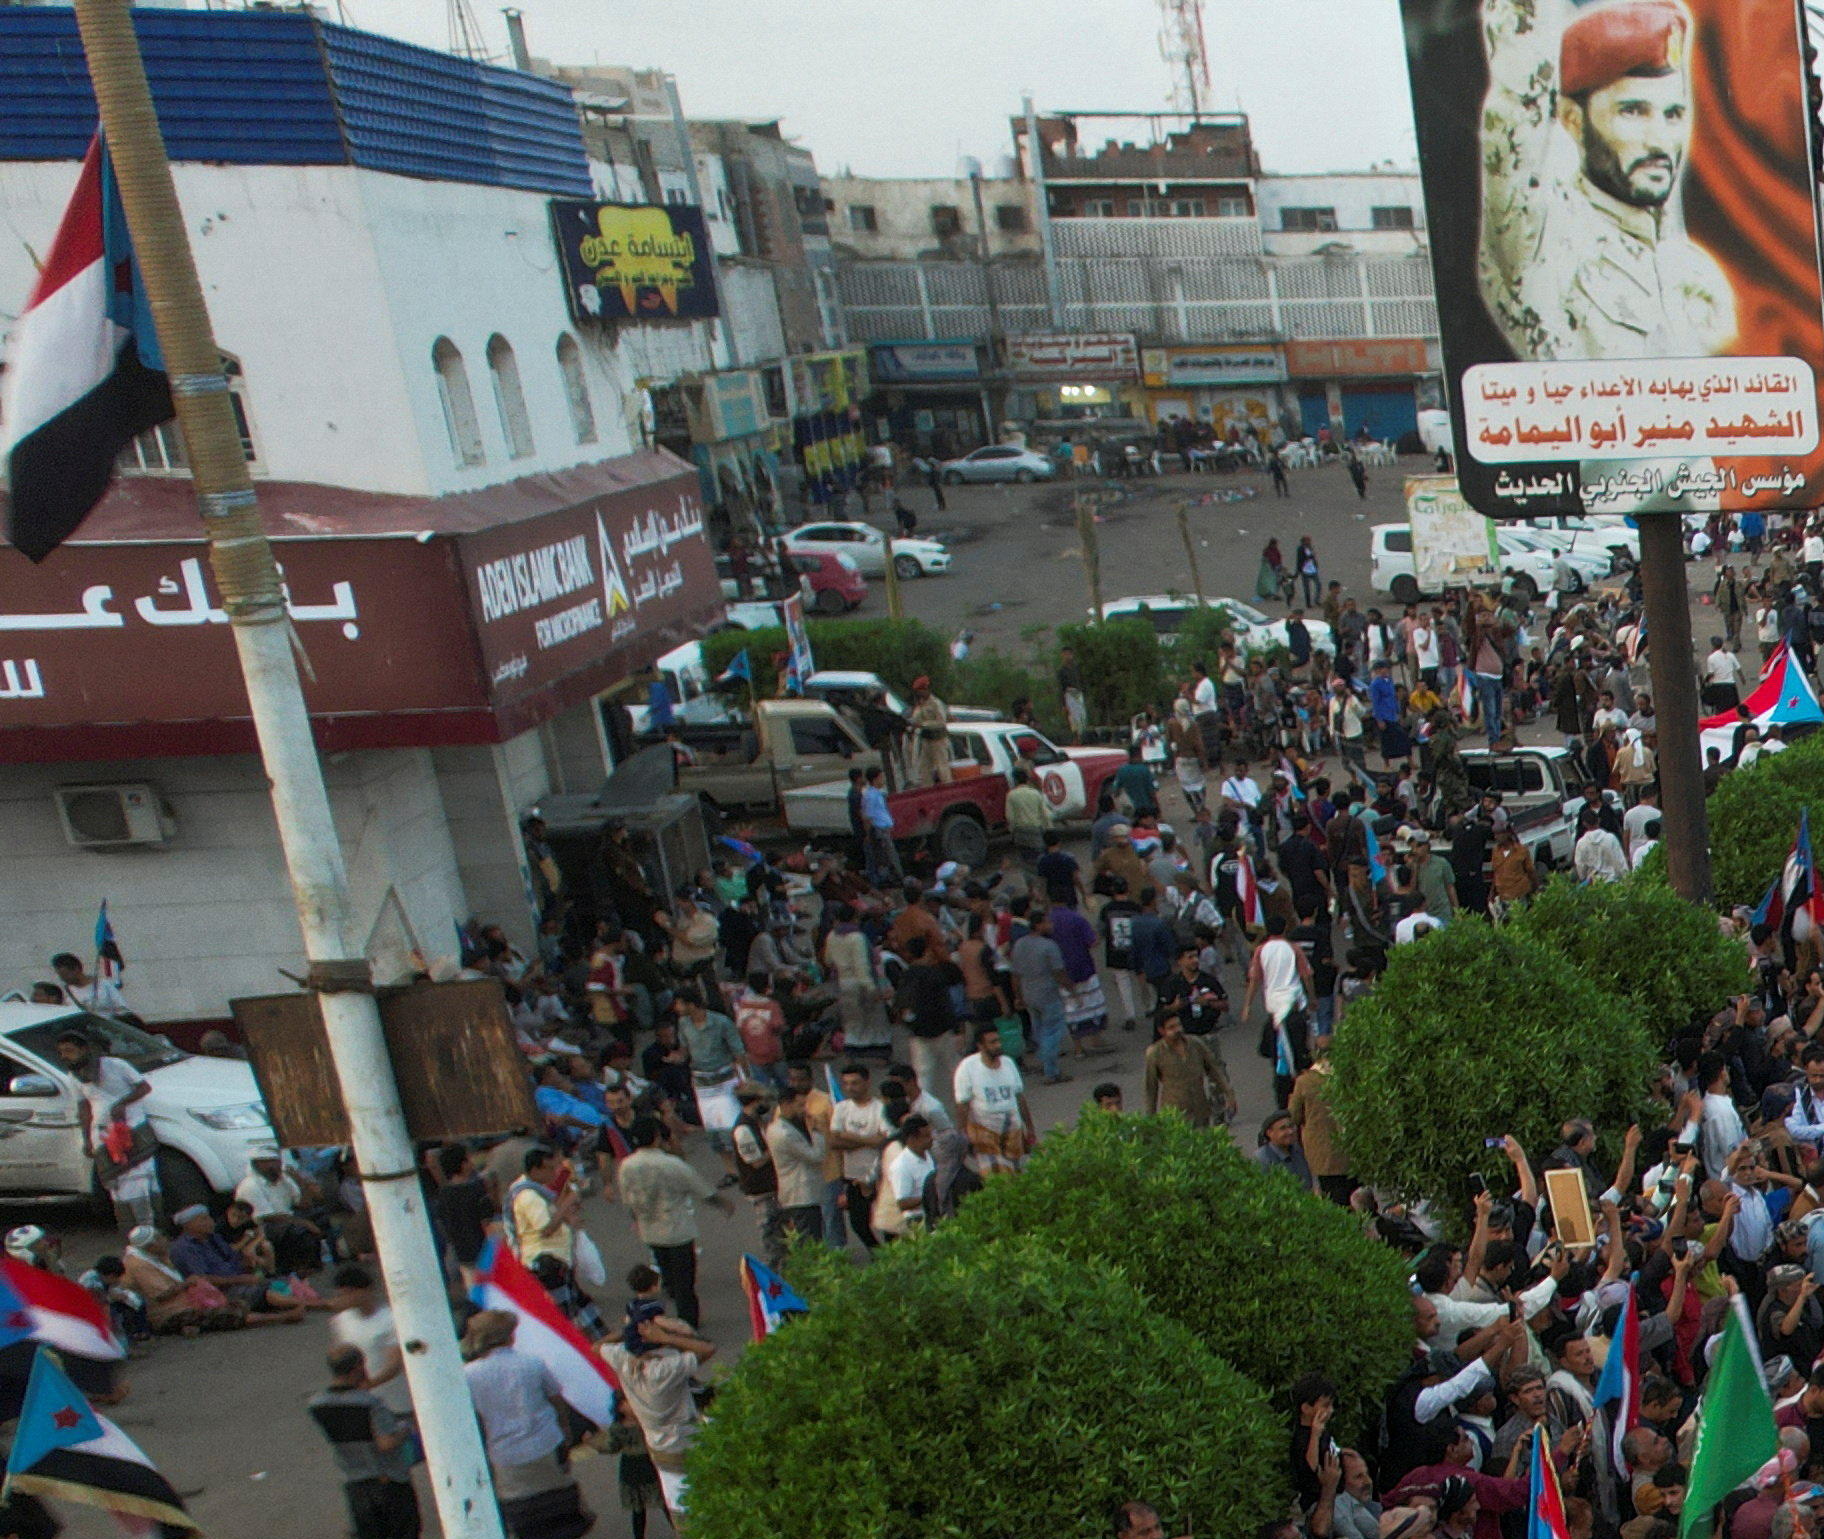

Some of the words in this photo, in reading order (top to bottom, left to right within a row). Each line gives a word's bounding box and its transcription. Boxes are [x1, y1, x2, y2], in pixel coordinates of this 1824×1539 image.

[1526, 386, 1535, 402] و
[1580, 374, 1643, 399] الأعداء
[1649, 375, 1695, 401] يهابه
[1699, 374, 1739, 401] الذي
[1743, 374, 1798, 394] القائد
[1479, 412, 1582, 450] اليمامة
[1588, 405, 1628, 449] أبو
[1632, 413, 1695, 449] منير
[1705, 409, 1805, 445] الشهيد
[1494, 468, 1574, 504] الحديث
[1578, 466, 1663, 507] الجنوبي
[1666, 463, 1737, 499] الجيش
[1741, 466, 1806, 496] مؤسس
[477, 556, 519, 624] ADEN
[513, 541, 565, 612] ISLAMIC
[556, 533, 595, 594] BANK
[534, 616, 554, 651] FOR
